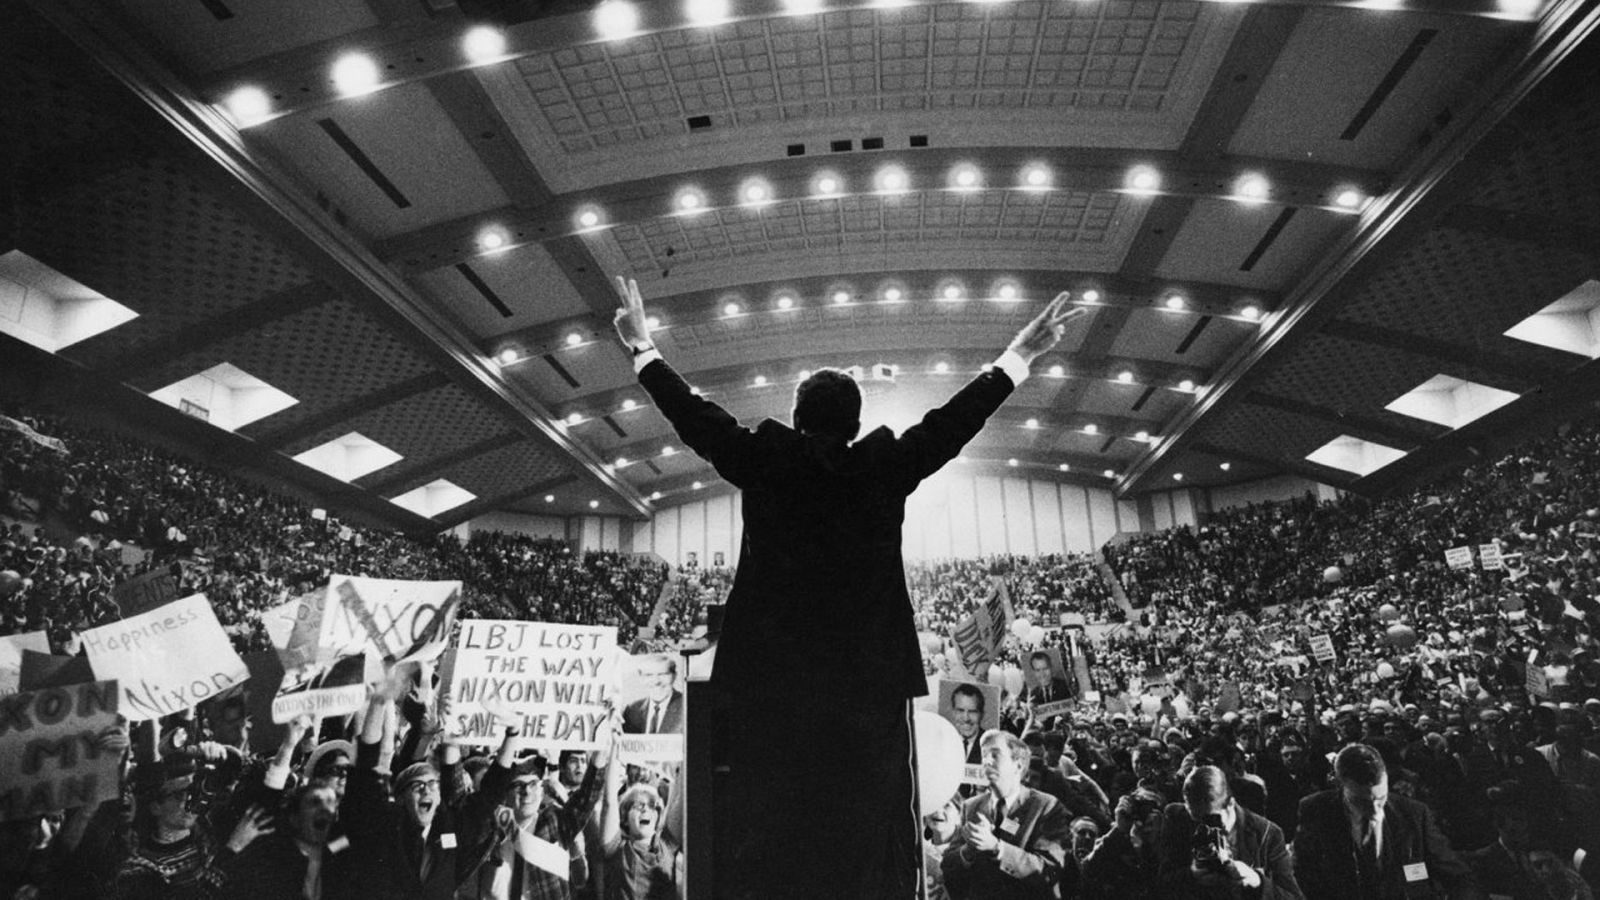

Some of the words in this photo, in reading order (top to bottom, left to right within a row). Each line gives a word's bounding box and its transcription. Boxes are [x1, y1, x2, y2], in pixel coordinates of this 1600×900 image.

[85, 608, 198, 655] Happiness
[466, 624, 528, 652] LBJ
[539, 629, 603, 651] LOST
[485, 655, 528, 674] THE
[542, 657, 604, 678] WAY
[124, 673, 234, 717] Nixon
[457, 678, 546, 703] NIXON
[552, 681, 606, 706] WILL
[456, 711, 496, 738] SAVE
[515, 711, 549, 738] HE
[552, 710, 606, 743] DAY
